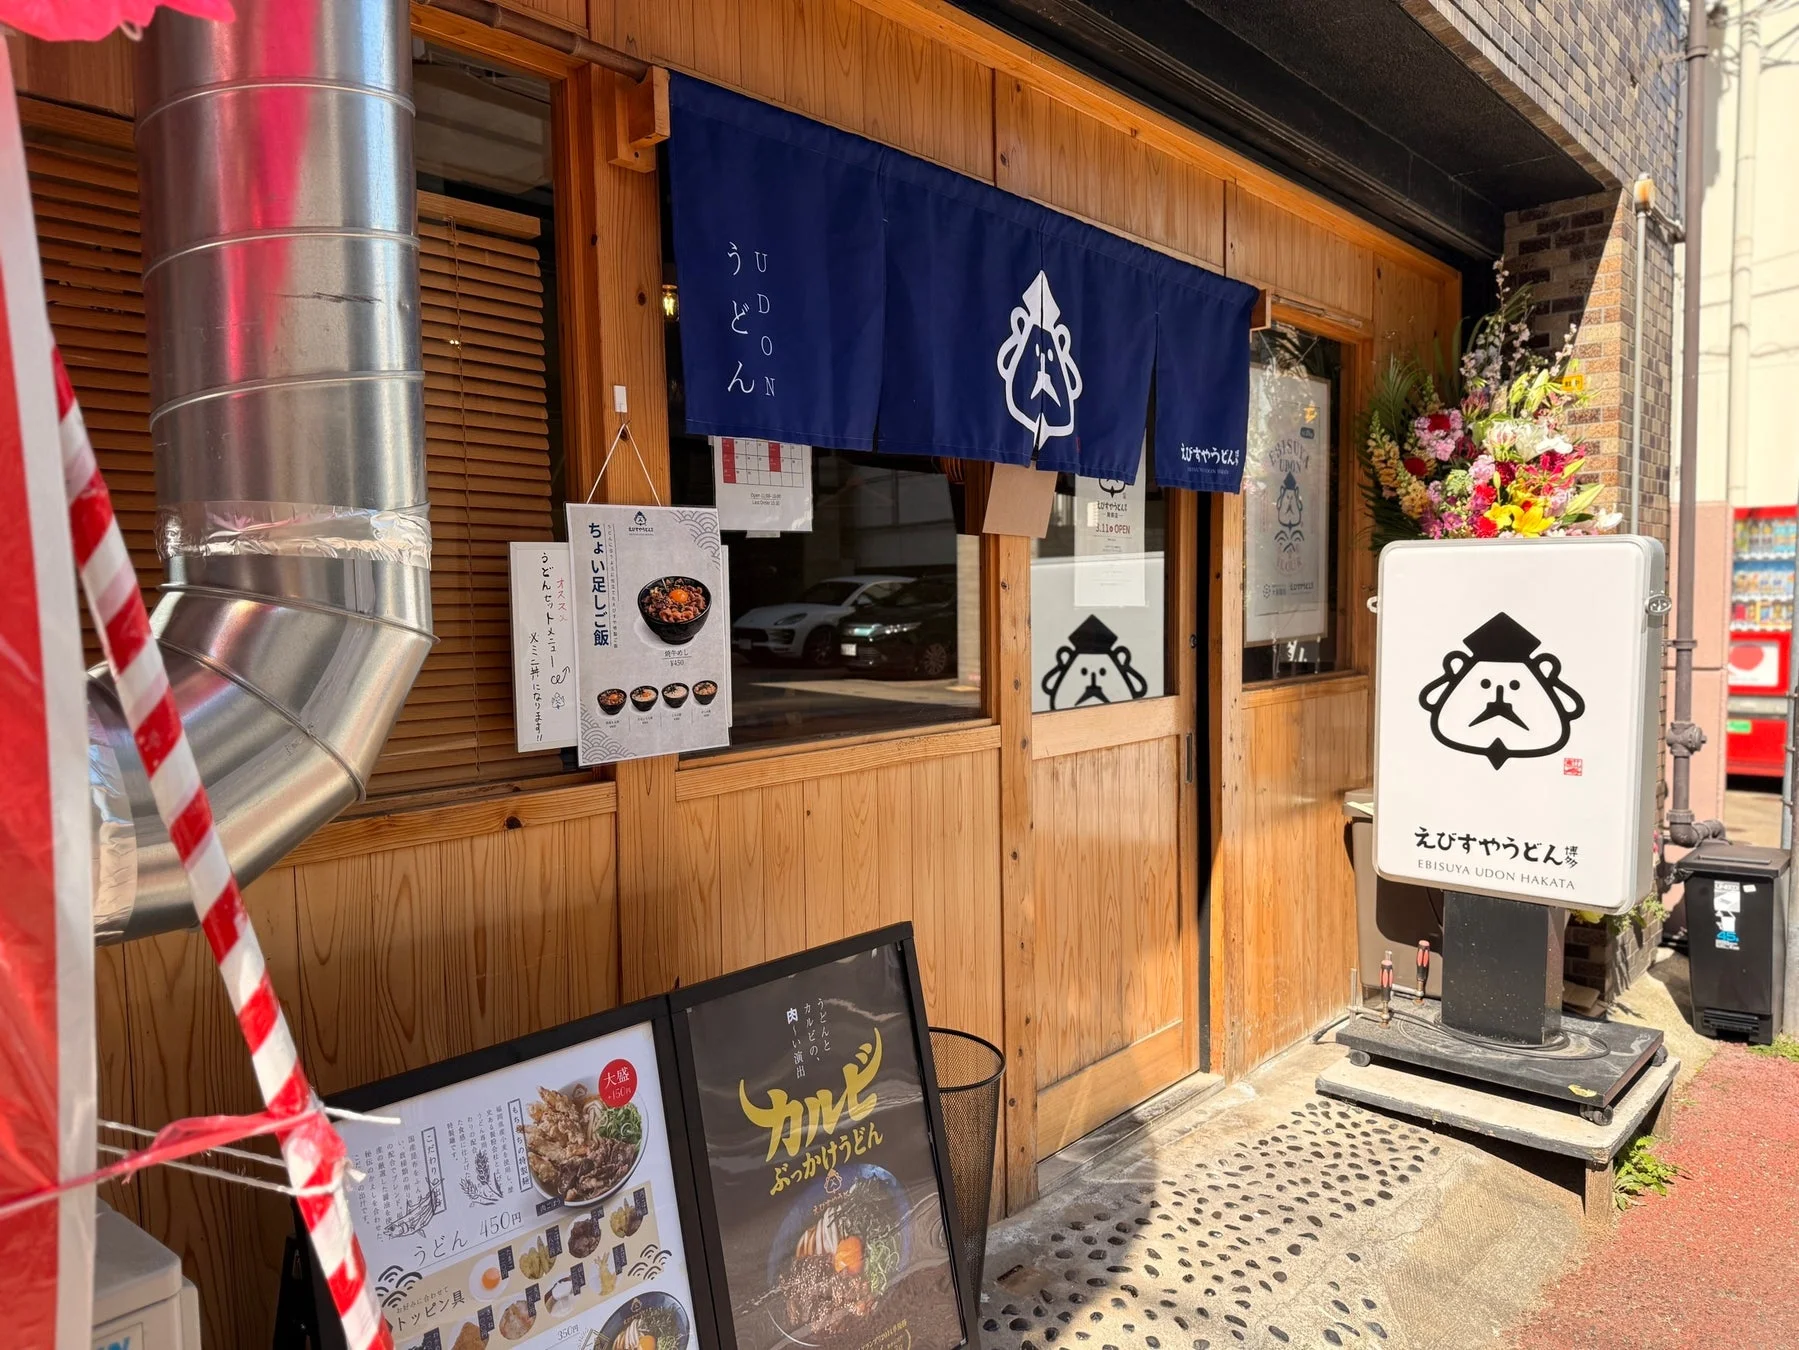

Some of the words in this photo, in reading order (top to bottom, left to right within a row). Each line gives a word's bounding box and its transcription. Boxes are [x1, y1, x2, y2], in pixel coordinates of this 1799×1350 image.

[727, 241, 754, 393] うどん
[755, 251, 775, 396] UDON
[556, 577, 568, 622] オススメ
[589, 522, 609, 646] ちょい足しご飯
[1413, 826, 1563, 867] えびすやうどん
[1418, 858, 1470, 876] EBISUYA
[1475, 866, 1515, 882] UDON
[1520, 873, 1576, 890] HAKATA
[603, 1066, 630, 1089] 大盛
[739, 1027, 882, 1162] カルビ
[769, 1122, 883, 1196] ぶっかけうどん
[479, 1211, 522, 1238] 450円
[414, 1230, 468, 1267] うどん
[397, 1290, 465, 1332] トッピン具
